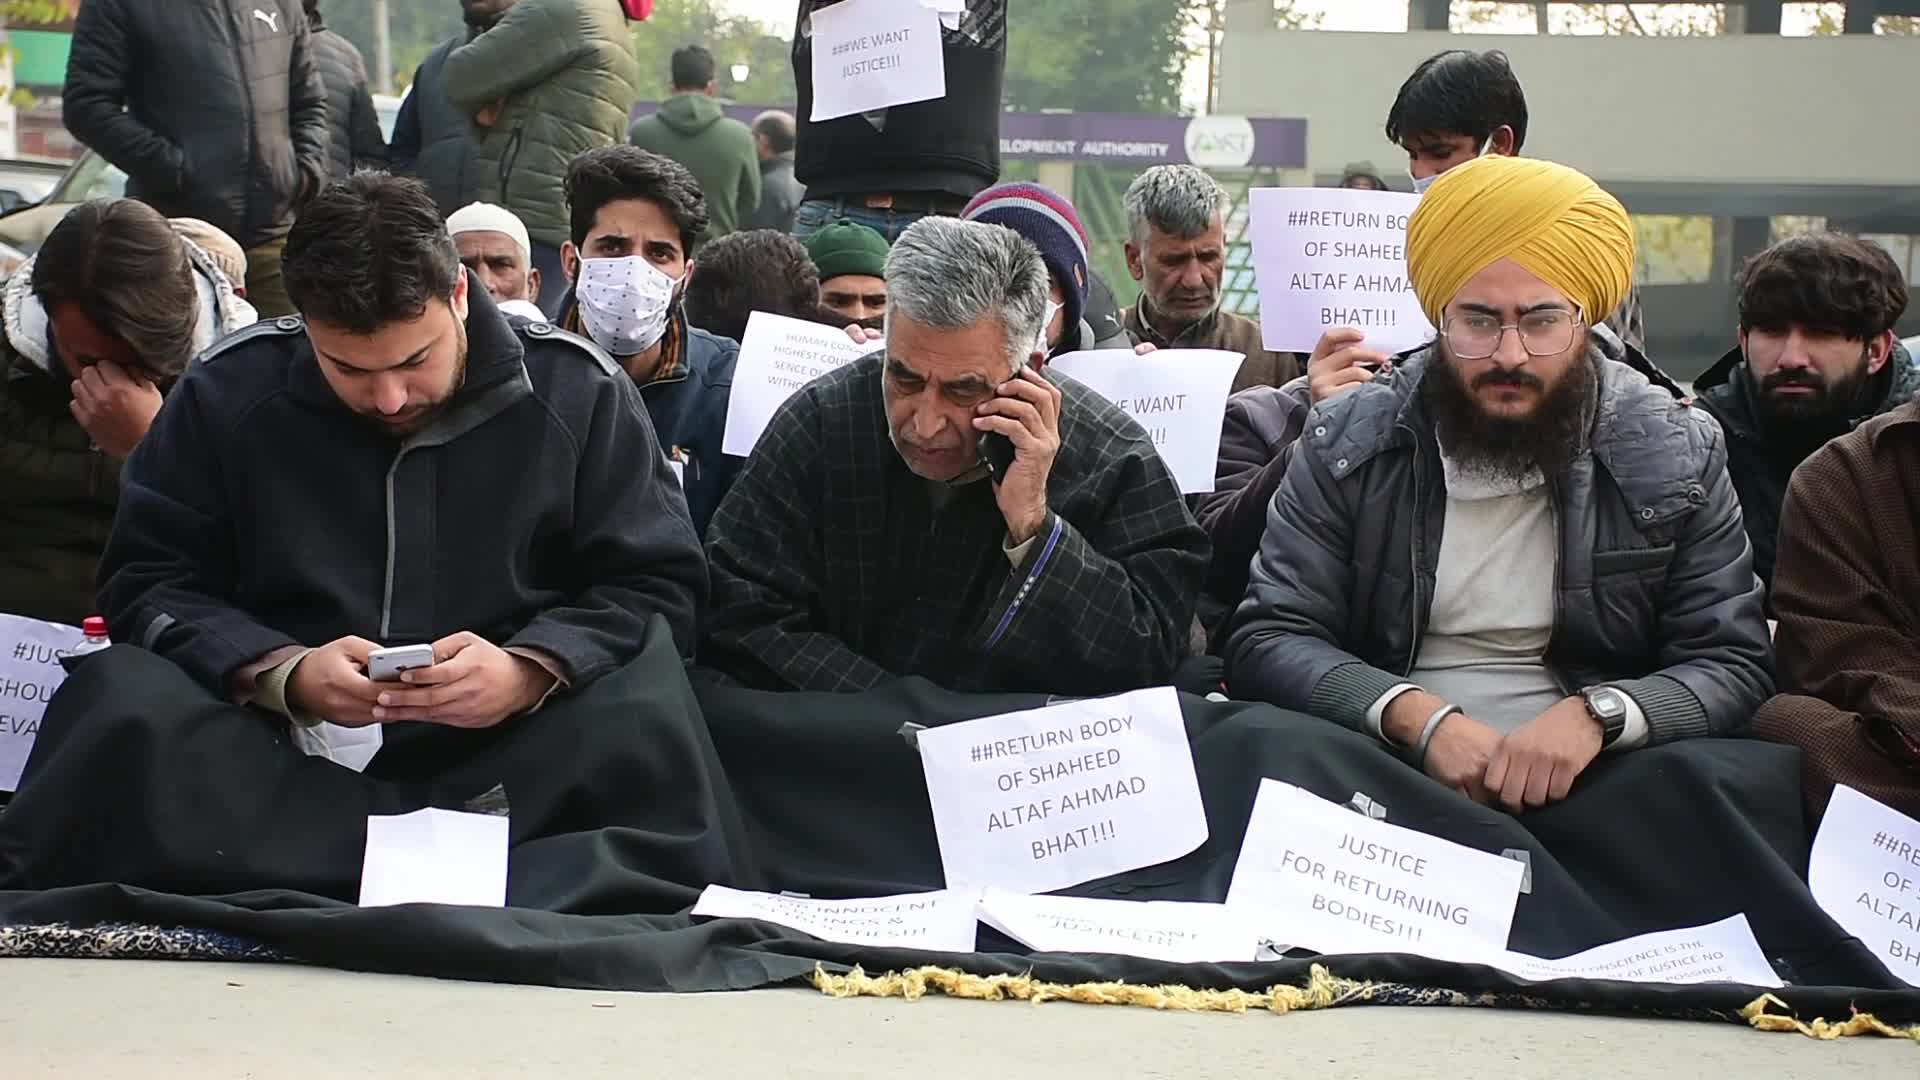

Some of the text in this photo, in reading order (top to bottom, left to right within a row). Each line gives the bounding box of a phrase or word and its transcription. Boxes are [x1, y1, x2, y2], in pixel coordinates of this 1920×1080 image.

[871, 29, 911, 48] WANT
[842, 54, 901, 78] JUSTICE!!!
[1081, 141, 1169, 157] AUTHORITY
[1288, 210, 1380, 229] ##RETURN
[1304, 241, 1329, 257] OF
[1290, 272, 1348, 291] ALTAF
[1320, 307, 1396, 327] BHAT!!!
[773, 344, 819, 361] HIGHEST
[774, 360, 808, 376] SENCE
[1134, 394, 1187, 415] WANT
[971, 715, 1134, 763] ##RETURN BODY
[997, 748, 1121, 793] OF SHAHEED
[987, 776, 1146, 833] ALTAF AHMAD
[1031, 819, 1117, 861] BHAT!!!
[1337, 833, 1429, 877] JUSTICE
[1281, 849, 1470, 926] FOR RETURNING
[1883, 871, 1913, 893] OF
[1311, 893, 1423, 943] BODIES!!!
[1664, 945, 1677, 954] IS
[1649, 956, 1698, 975] JUSTICE
[1701, 950, 1725, 962] NO
